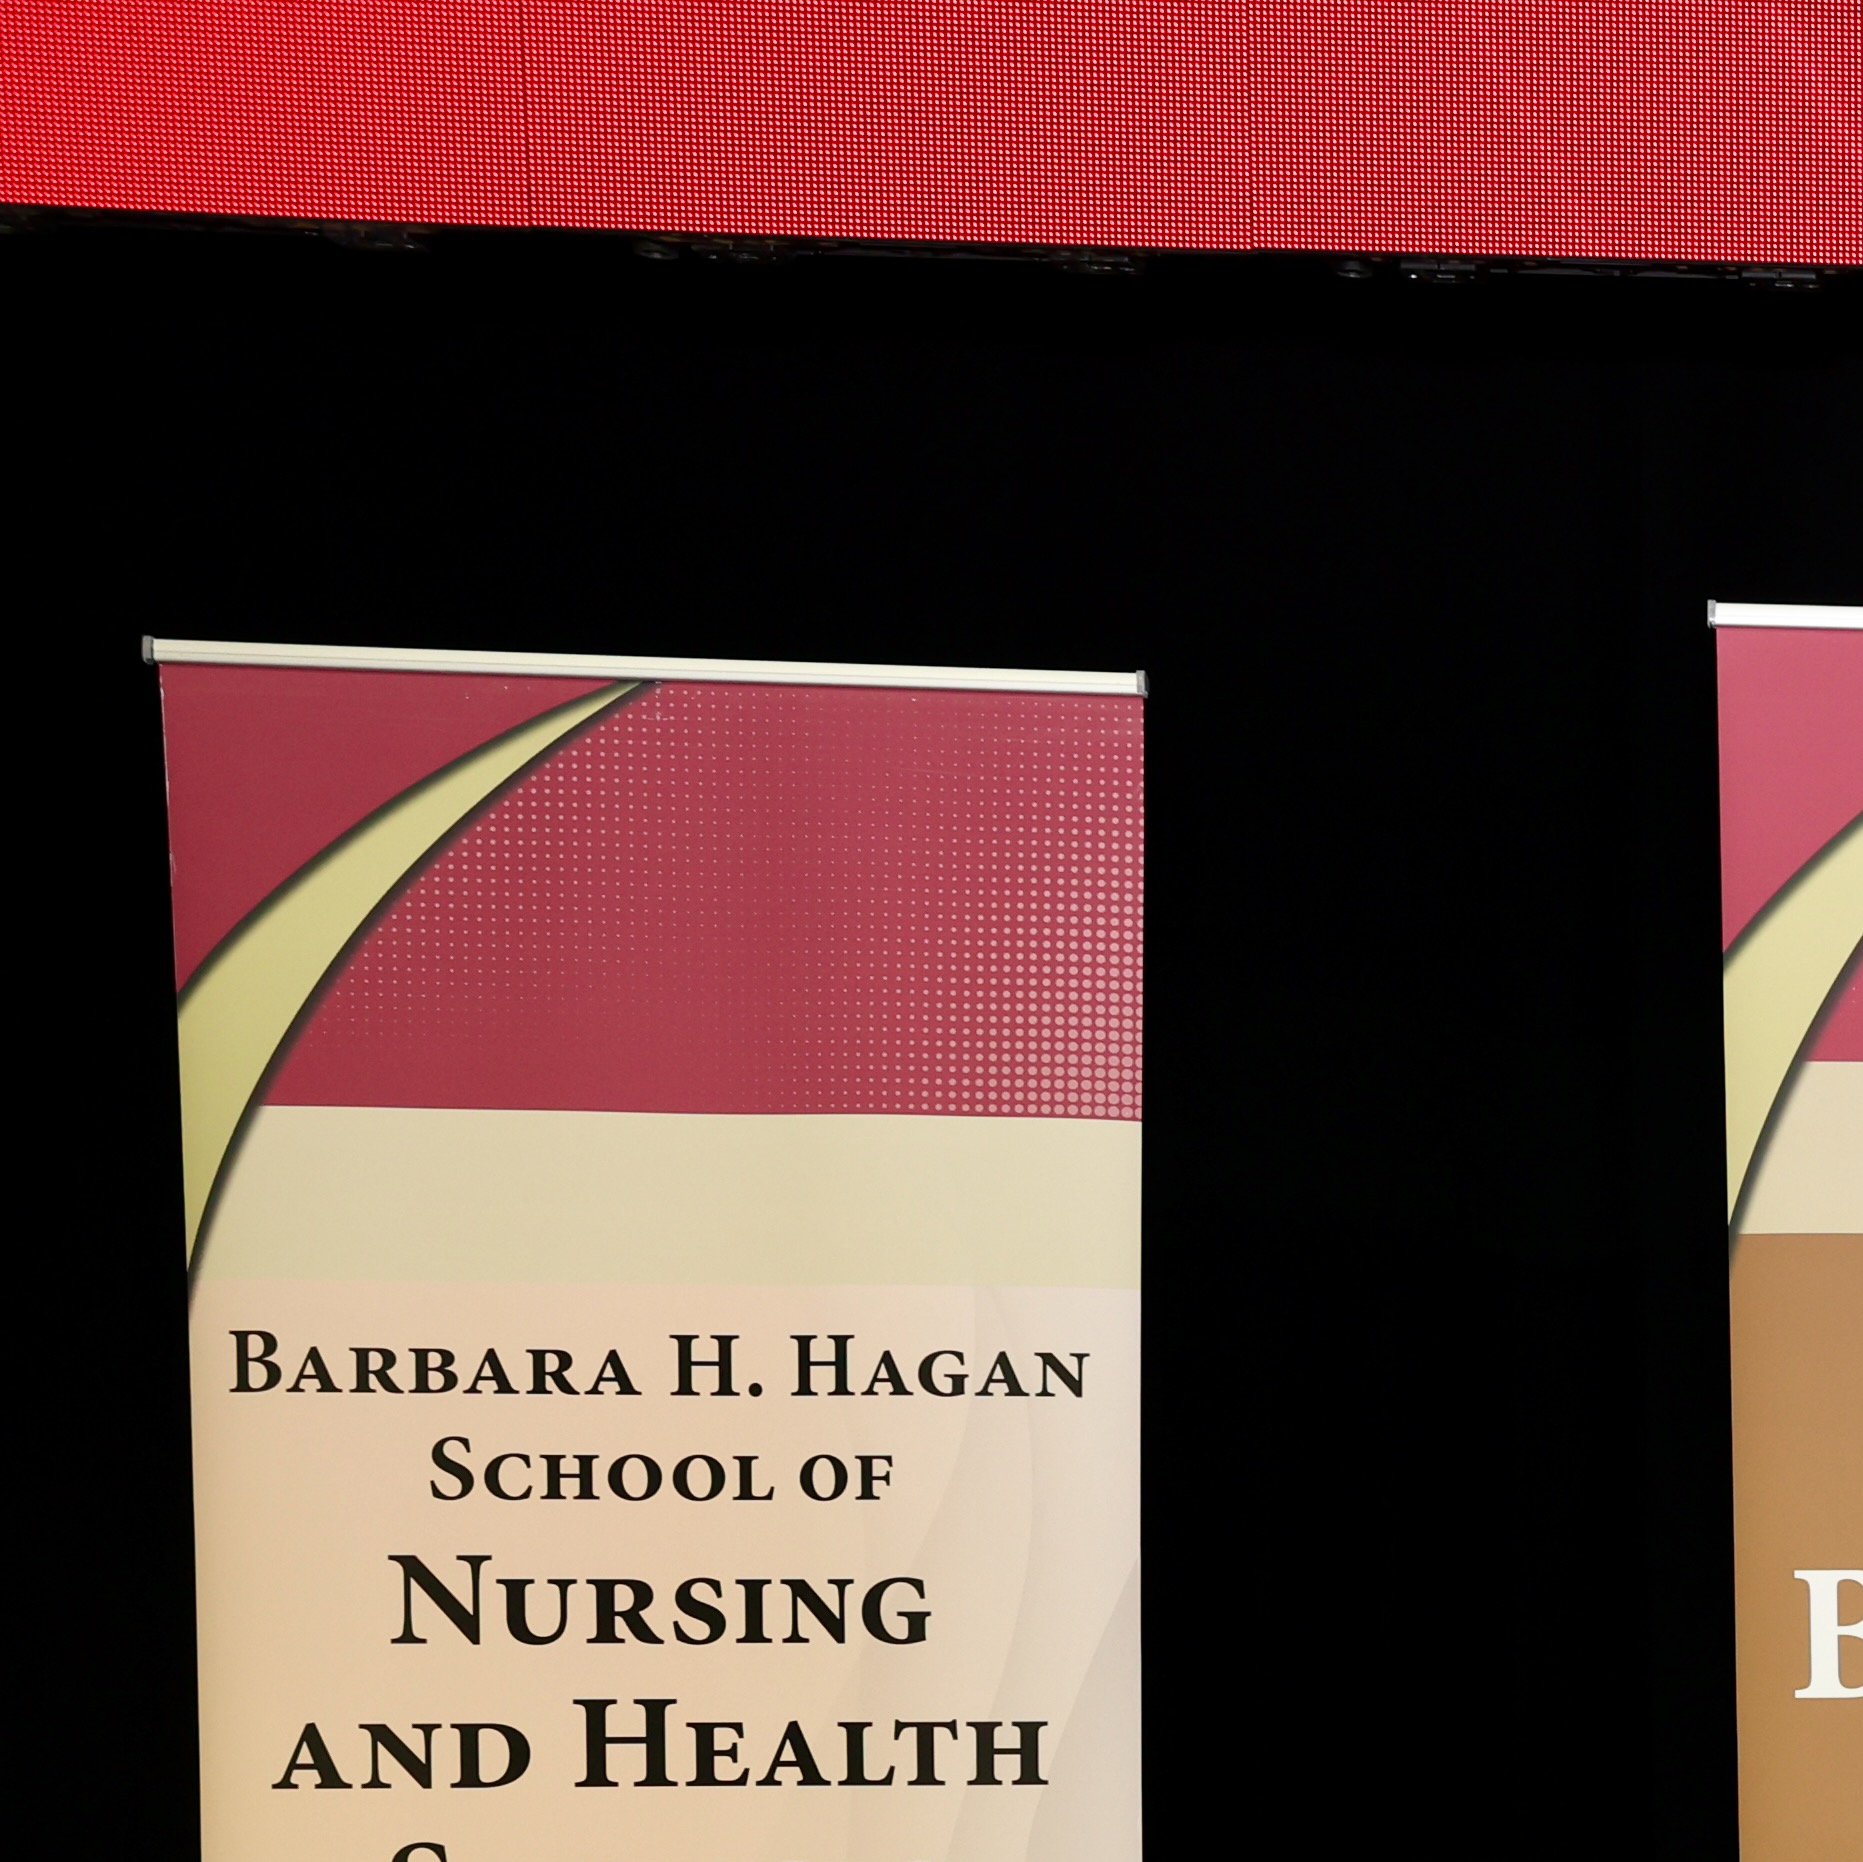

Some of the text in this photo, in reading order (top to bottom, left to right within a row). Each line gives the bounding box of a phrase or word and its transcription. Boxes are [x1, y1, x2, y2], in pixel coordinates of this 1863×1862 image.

[228, 1330, 1090, 1398] BARBARA H. HAGAN
[430, 1436, 893, 1502] SCHOOL OF
[387, 1554, 932, 1646] NURSING
[271, 1698, 1049, 1790] AND HEALTH
